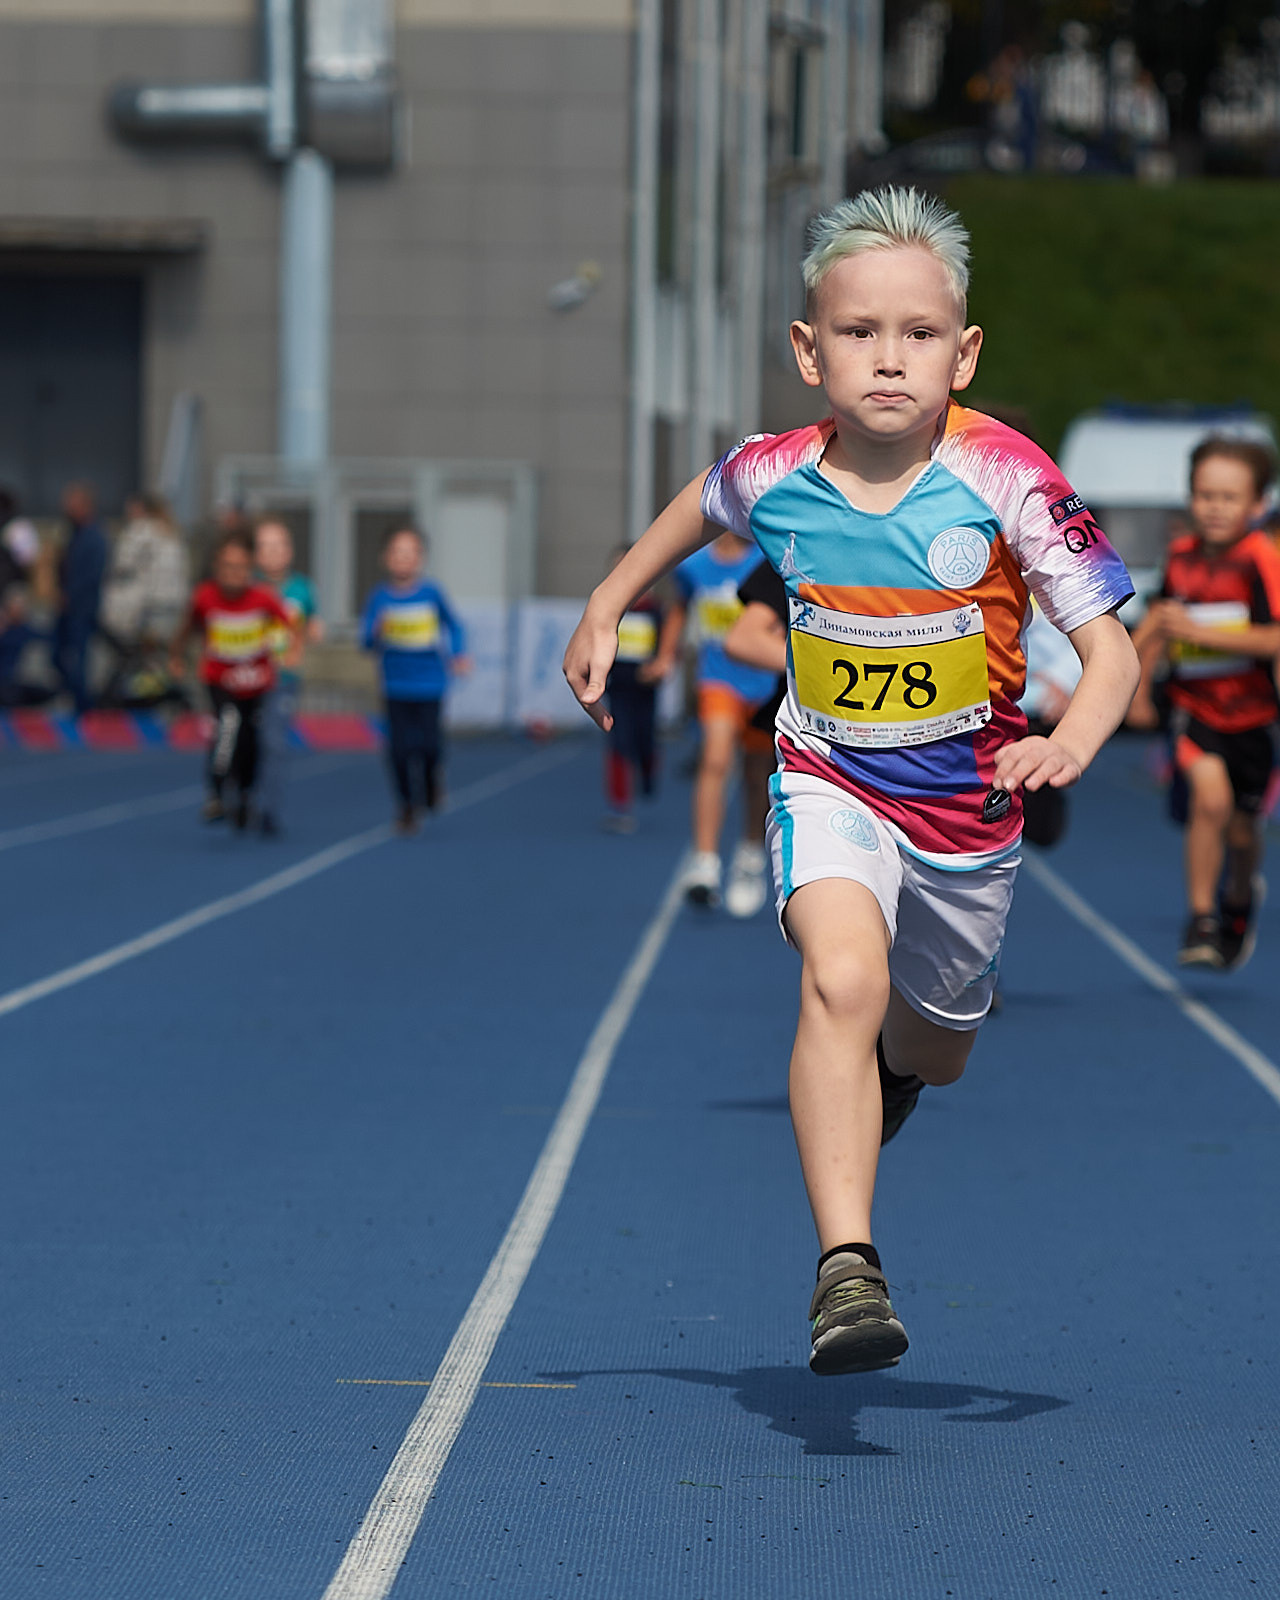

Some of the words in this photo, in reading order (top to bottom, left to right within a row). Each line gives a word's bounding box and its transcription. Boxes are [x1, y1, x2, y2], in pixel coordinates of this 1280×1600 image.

[940, 534, 979, 549] PARIS
[819, 617, 902, 638] Динамовская
[906, 625, 943, 638] миля
[832, 659, 937, 711] 278
